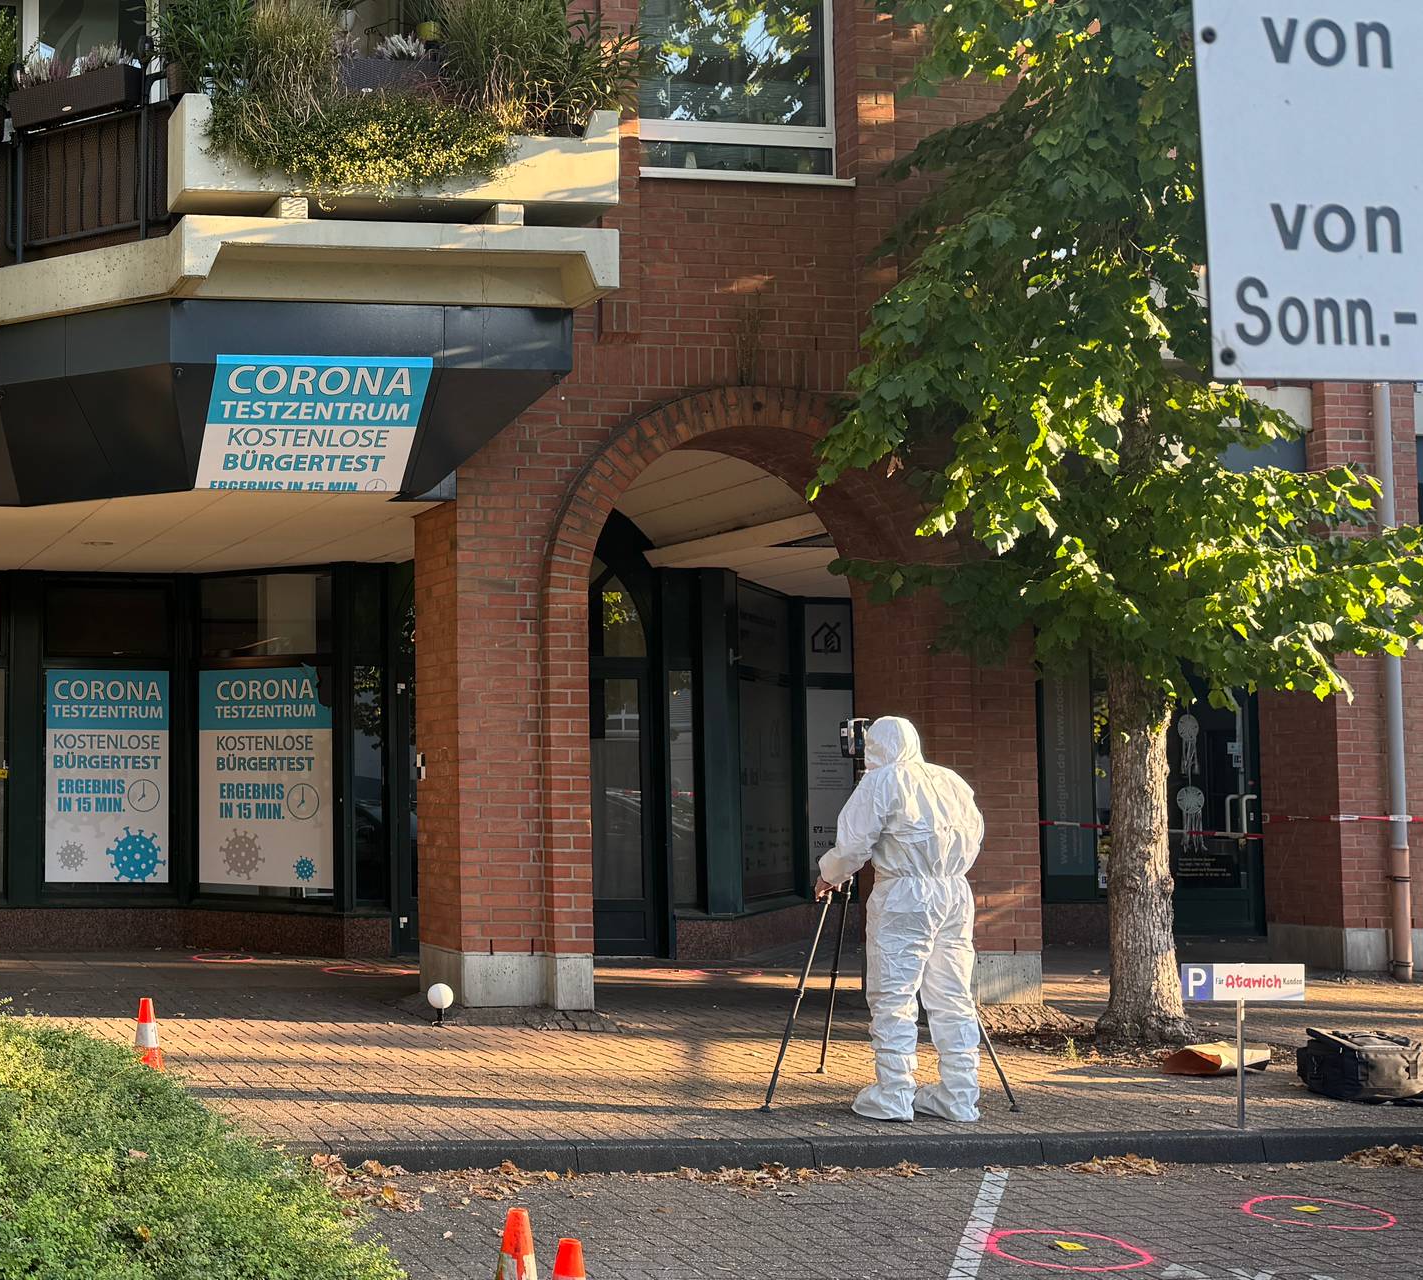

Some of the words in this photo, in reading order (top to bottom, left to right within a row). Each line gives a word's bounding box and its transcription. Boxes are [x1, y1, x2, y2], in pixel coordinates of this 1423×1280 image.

[1261, 17, 1393, 69] von
[1270, 203, 1402, 253] von
[1235, 276, 1417, 346] Sonn.-
[228, 365, 413, 396] CORONA
[220, 400, 410, 421] TESTZENTRUM
[227, 427, 389, 448] KOSTENLOSE
[222, 450, 385, 472] BÜRGERTEST
[287, 481, 304, 491] IN
[306, 481, 326, 491] 15
[54, 679, 162, 701] CORONA
[216, 678, 314, 701] CORONA
[52, 704, 163, 719] TESTZENTRUM
[215, 703, 316, 719] TESTZENTRUM
[53, 733, 160, 750] KOSTENLOSE
[216, 735, 314, 751] KOSTENLOSE
[52, 752, 161, 770] BÜRGERTEST
[216, 753, 315, 772] BÜRGERTEST
[57, 778, 126, 795] ERGEBNIS
[219, 783, 285, 800] ERGEBNIS
[57, 797, 72, 812] IN
[75, 797, 91, 812] 15
[94, 797, 126, 813] MIN.
[219, 802, 233, 819] IN
[236, 802, 251, 819] 15
[255, 803, 285, 820] MIN.
[1188, 967, 1207, 997] P
[1225, 975, 1282, 989] Atawich
